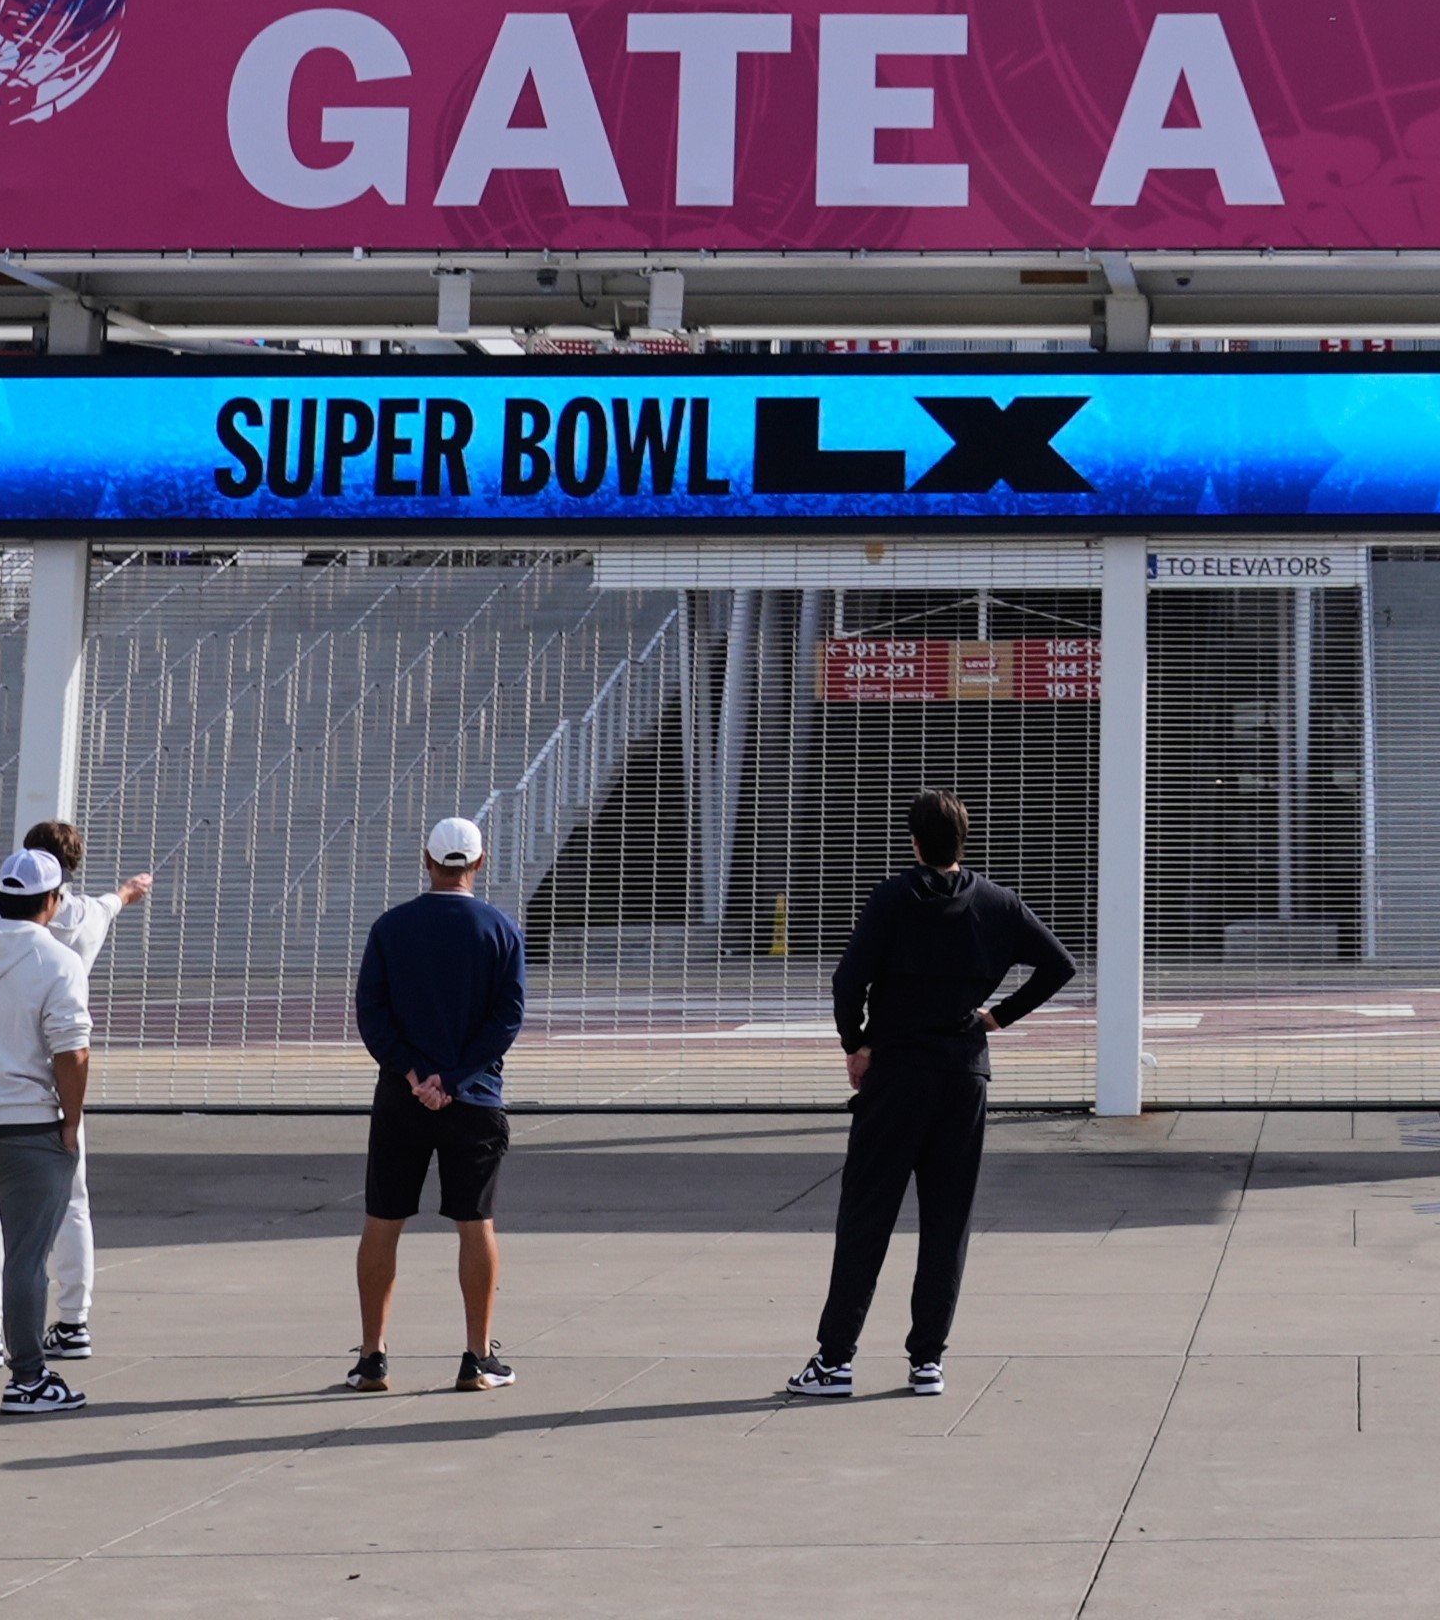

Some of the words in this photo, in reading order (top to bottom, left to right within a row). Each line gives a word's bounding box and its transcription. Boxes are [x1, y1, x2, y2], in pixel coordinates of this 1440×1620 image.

[226, 7, 969, 209] GATE
[1090, 12, 1285, 207] A
[214, 396, 472, 499] SUPER
[501, 395, 730, 497] BOWL
[752, 395, 1098, 494] LX
[1166, 557, 1195, 576] TO
[1203, 557, 1332, 576] ELEVATORS
